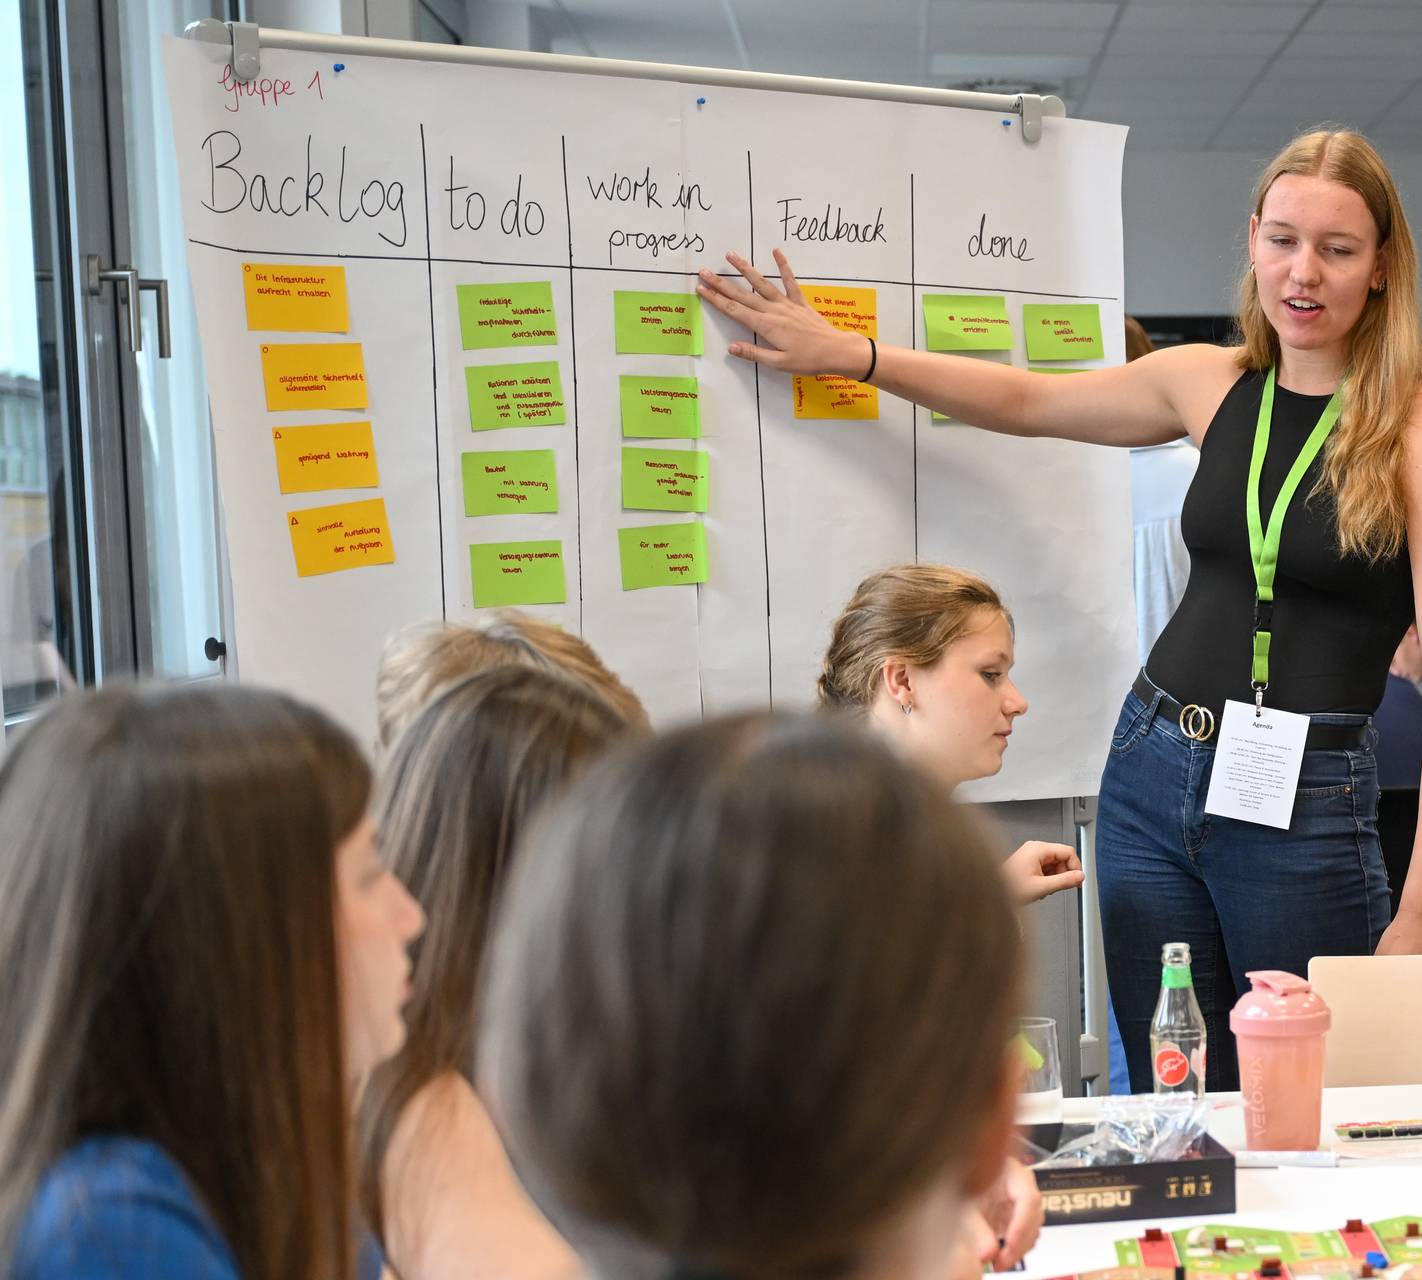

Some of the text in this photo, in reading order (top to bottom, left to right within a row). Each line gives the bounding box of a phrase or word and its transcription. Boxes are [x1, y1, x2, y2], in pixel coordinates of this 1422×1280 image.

[217, 64, 323, 112] Gruppe 1
[200, 130, 408, 248] Backlog
[444, 155, 545, 238] to do
[587, 166, 712, 212] work in
[777, 198, 888, 243] Feedback
[967, 213, 1035, 262] done
[608, 227, 706, 266] progress
[256, 273, 326, 285] Die Infrastruktur
[257, 287, 291, 297] aufrecht
[818, 310, 849, 319] schiedene
[279, 372, 318, 386] allgemeine
[298, 451, 331, 466] genügend
[1252, 721, 1273, 730] Agenda
[1250, 1056, 1267, 1138] VELOMIX
[1042, 1189, 1132, 1215] neustar
